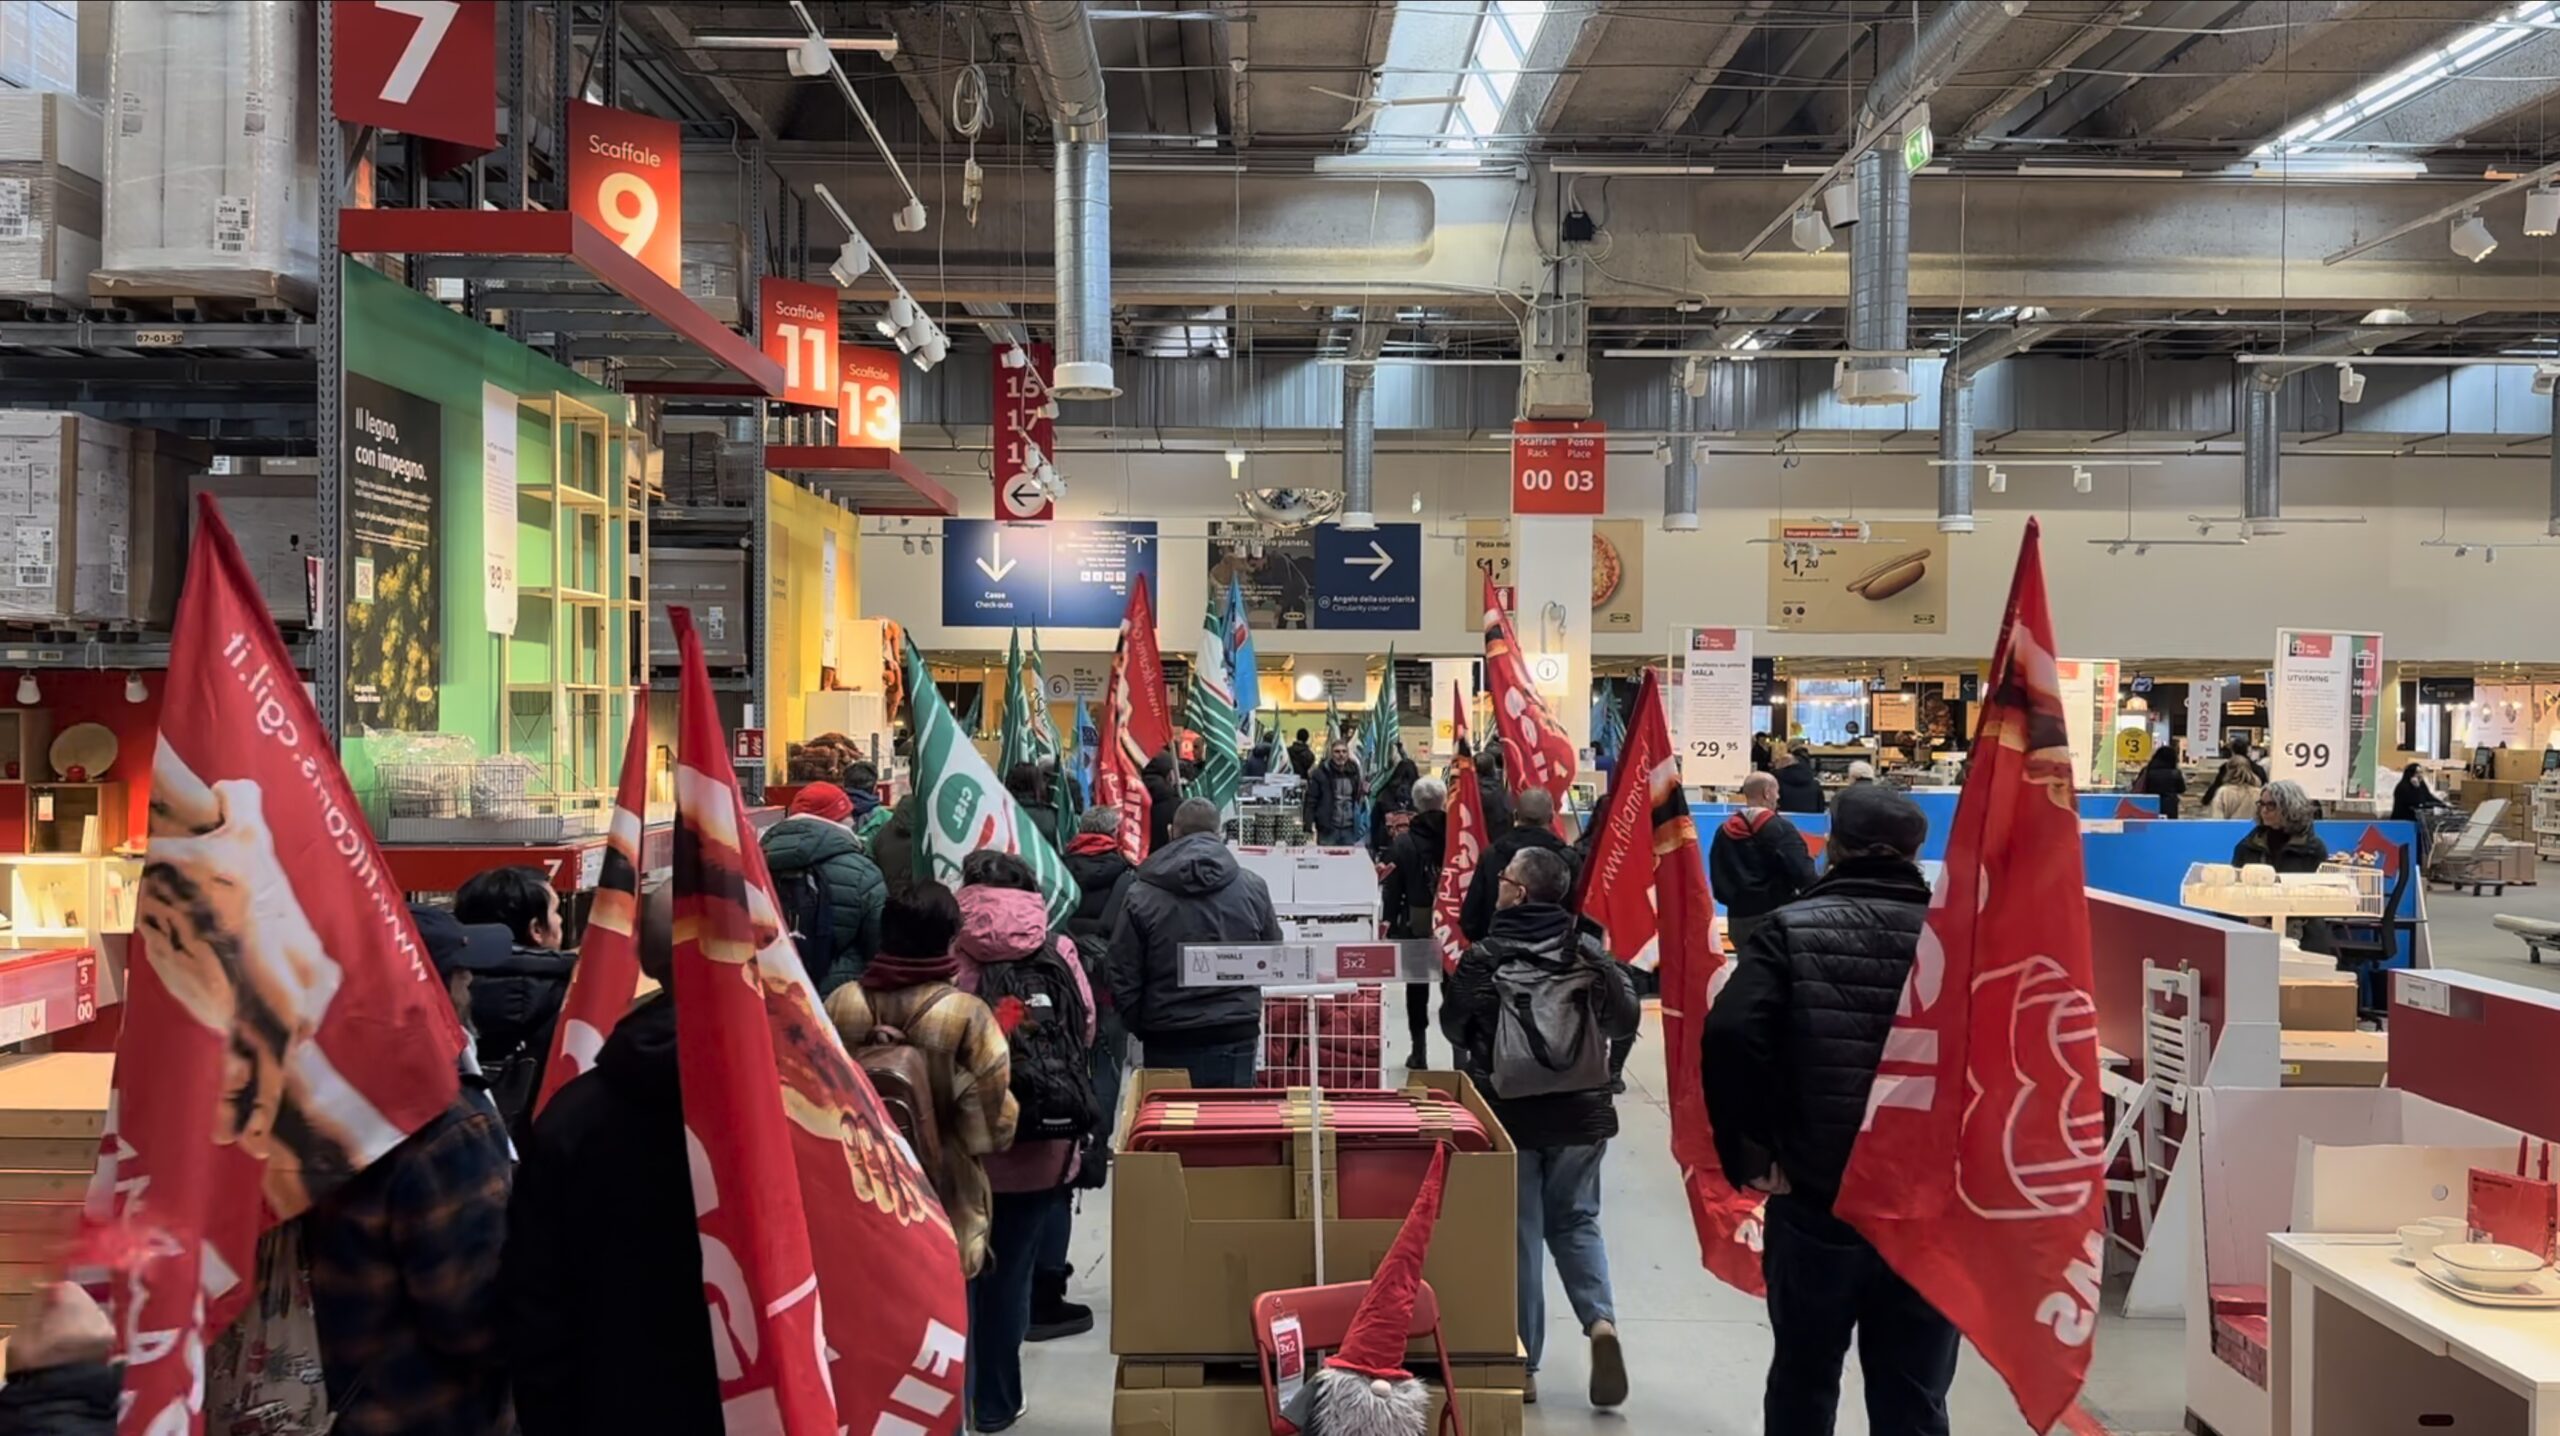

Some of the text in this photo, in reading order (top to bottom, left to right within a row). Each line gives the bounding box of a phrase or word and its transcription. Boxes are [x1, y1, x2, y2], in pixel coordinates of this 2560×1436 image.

[589, 133, 662, 169] Scaffale
[596, 172, 660, 258] 9
[775, 301, 825, 322] Scaffale
[776, 323, 828, 392] 11
[848, 363, 890, 381] Scaffale
[1006, 376, 1041, 398] 15
[841, 381, 898, 441] 13
[1007, 409, 1039, 431] 17
[355, 407, 399, 445] Il legno,
[1519, 437, 1595, 448] Scaffale Posto
[1527, 449, 1592, 459] Rack Place
[355, 446, 427, 484] con impegno.
[1522, 469, 1594, 491] 00 03
[1332, 605, 1365, 613] Circularity
[1333, 595, 1416, 605] Angolo della circolarità
[1053, 681, 1062, 694] 6
[2287, 675, 2329, 684] UTVISNING
[2199, 702, 2211, 741] scelta
[1690, 741, 1738, 760] €29,95
[2285, 743, 2330, 768] €99
[1343, 958, 1366, 969] 3x2
[80, 967, 89, 985] 5
[77, 1001, 92, 1021] 00
[1279, 1341, 1296, 1355] 3x2
